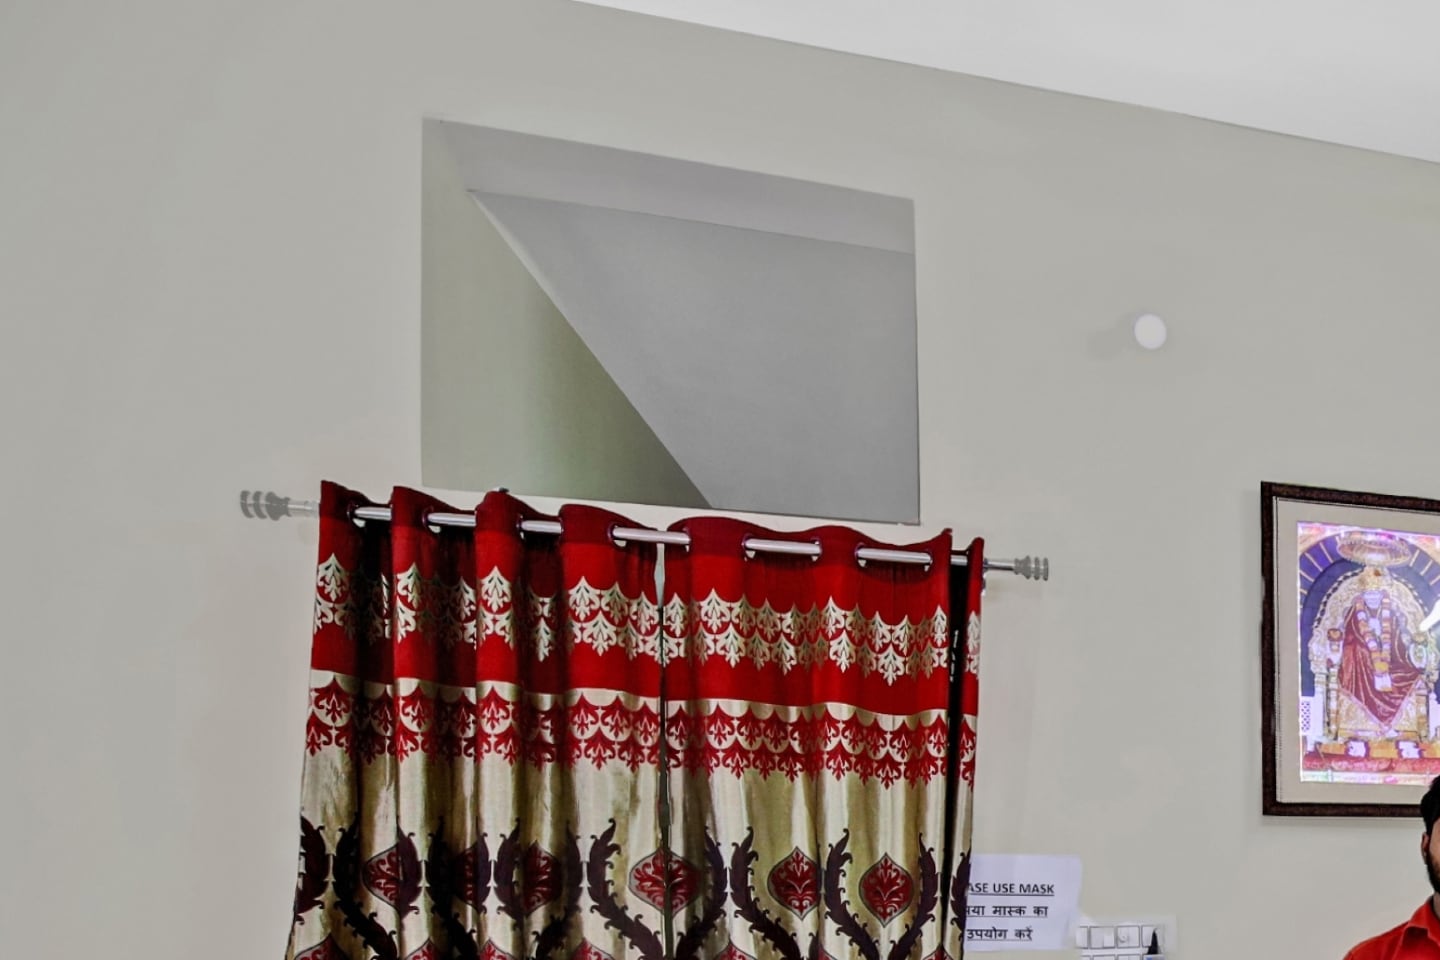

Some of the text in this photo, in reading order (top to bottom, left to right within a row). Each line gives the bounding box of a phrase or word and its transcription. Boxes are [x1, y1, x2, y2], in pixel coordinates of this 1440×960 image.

[968, 882, 1055, 894] ASE USE MASK
[992, 905, 1027, 917] मास्क
[1033, 905, 1049, 917] का
[966, 925, 1034, 941] उपयोग करें
